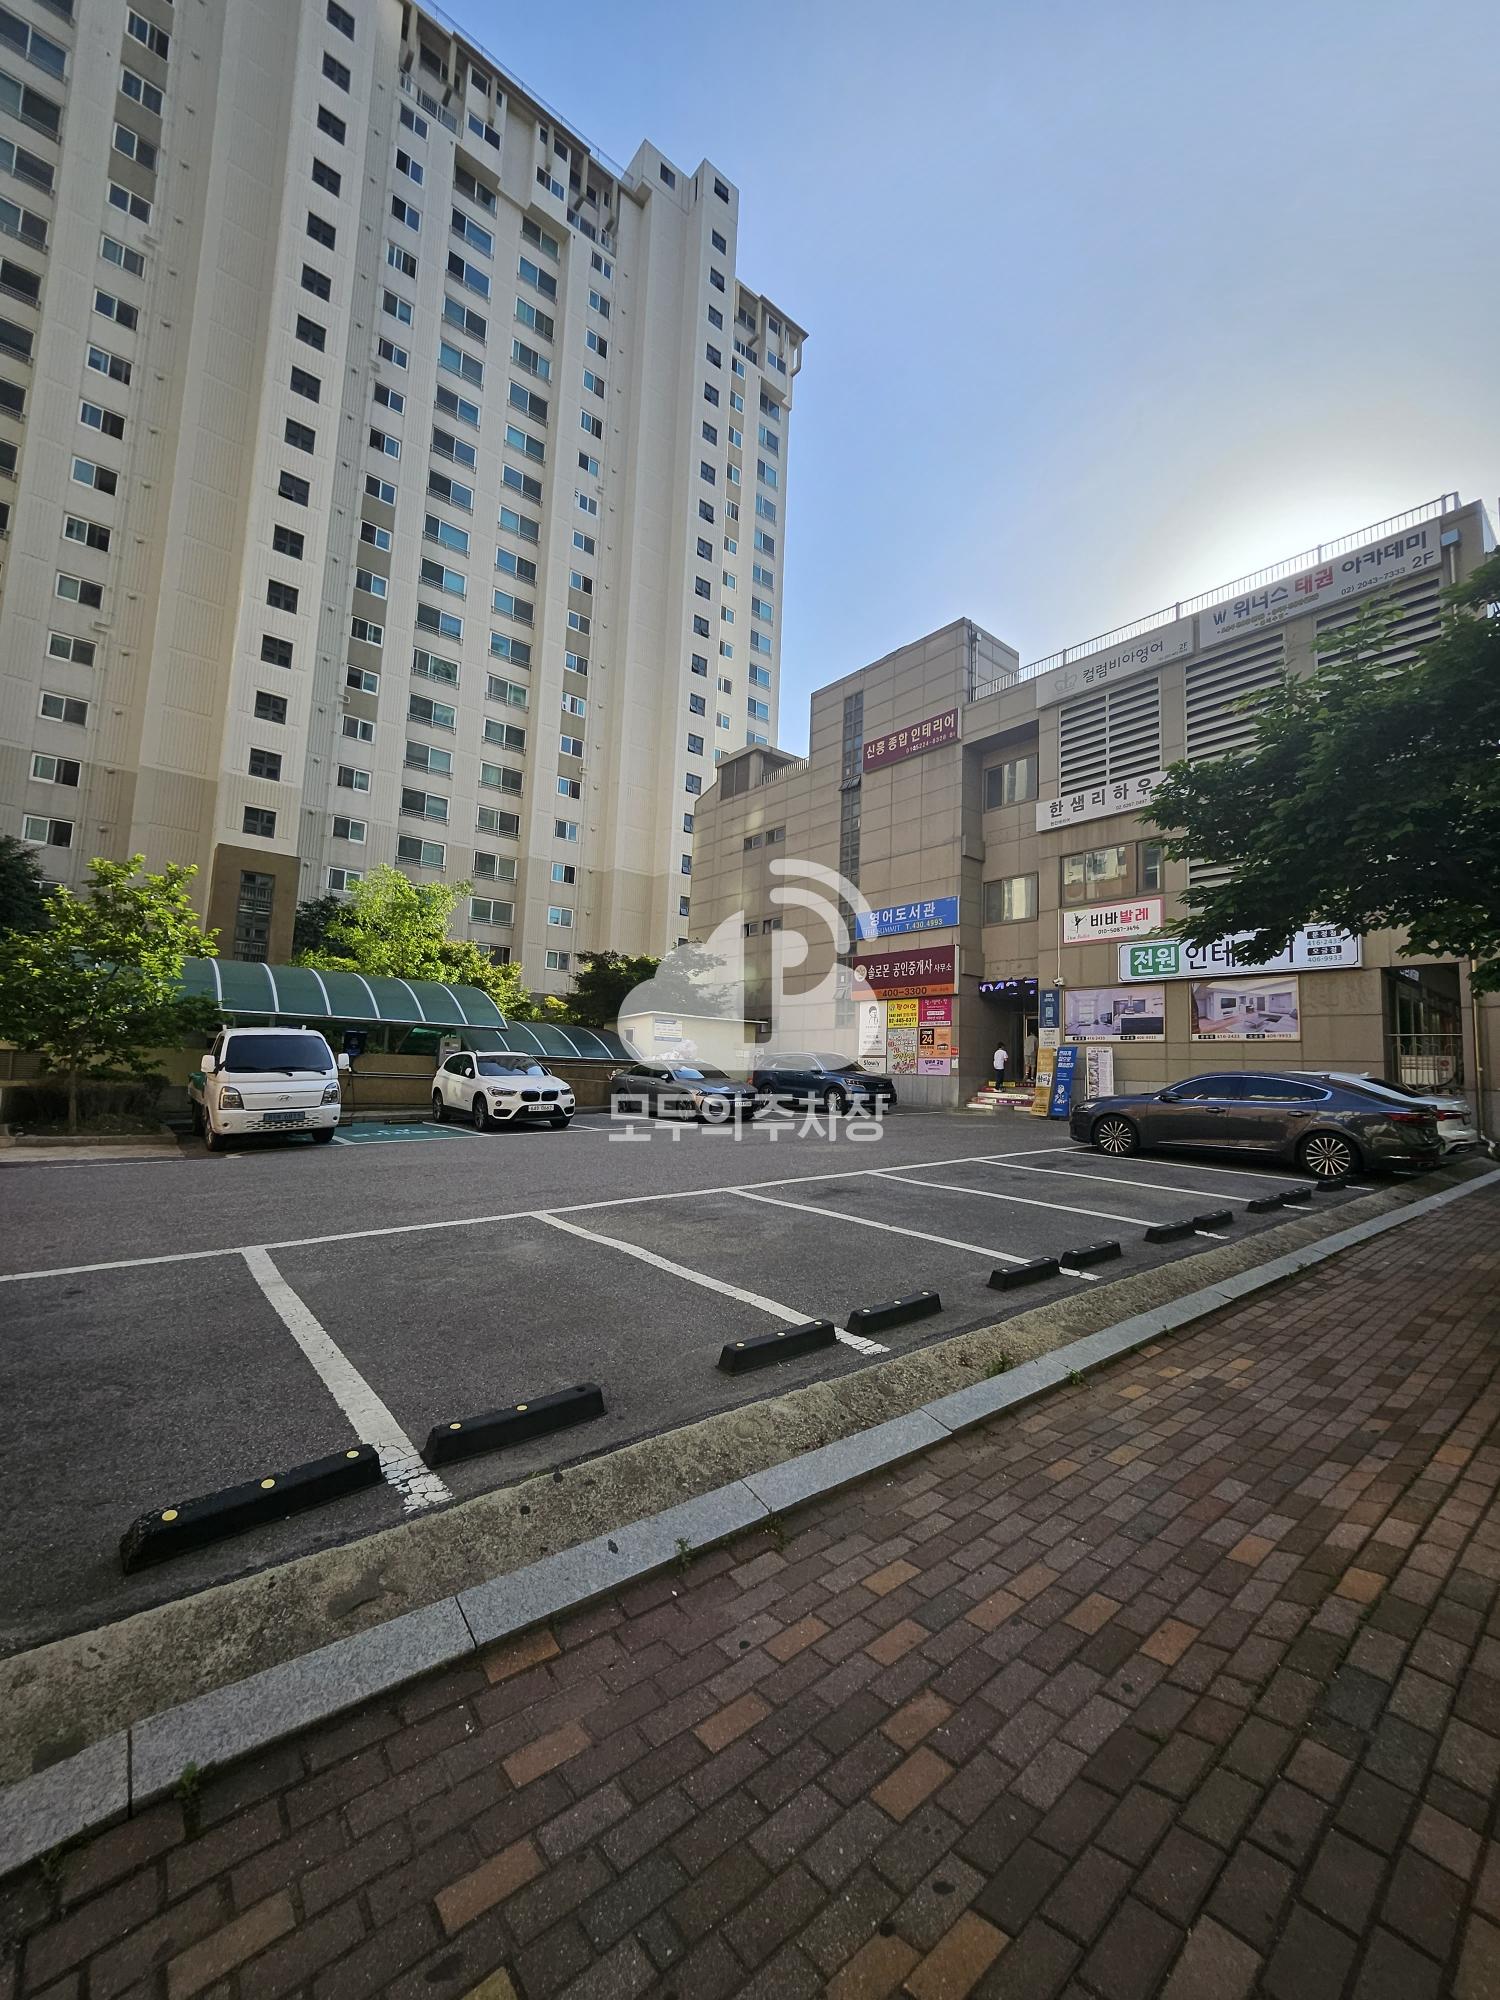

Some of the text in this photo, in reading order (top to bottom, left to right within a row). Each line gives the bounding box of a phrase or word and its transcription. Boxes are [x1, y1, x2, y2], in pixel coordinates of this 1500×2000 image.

[1412, 550, 1435, 569] 2F
[1233, 586, 1289, 619] 위너스
[1295, 566, 1334, 594] 태권
[1341, 530, 1427, 574] 아카데미
[1357, 567, 1406, 589] 2043-7333
[1082, 641, 1164, 683] 컬럼비아영어
[866, 713, 955, 759] 신흥 종합 인테리어
[869, 902, 936, 926] 영어도서관
[1090, 908, 1149, 926] 비바발레
[1133, 939, 1294, 974] 전원 인테어
[868, 959, 952, 980] 솔로몬 공인중개사 사무소
[882, 987, 927, 997] 400-3300
[922, 1035, 933, 1044] 24
